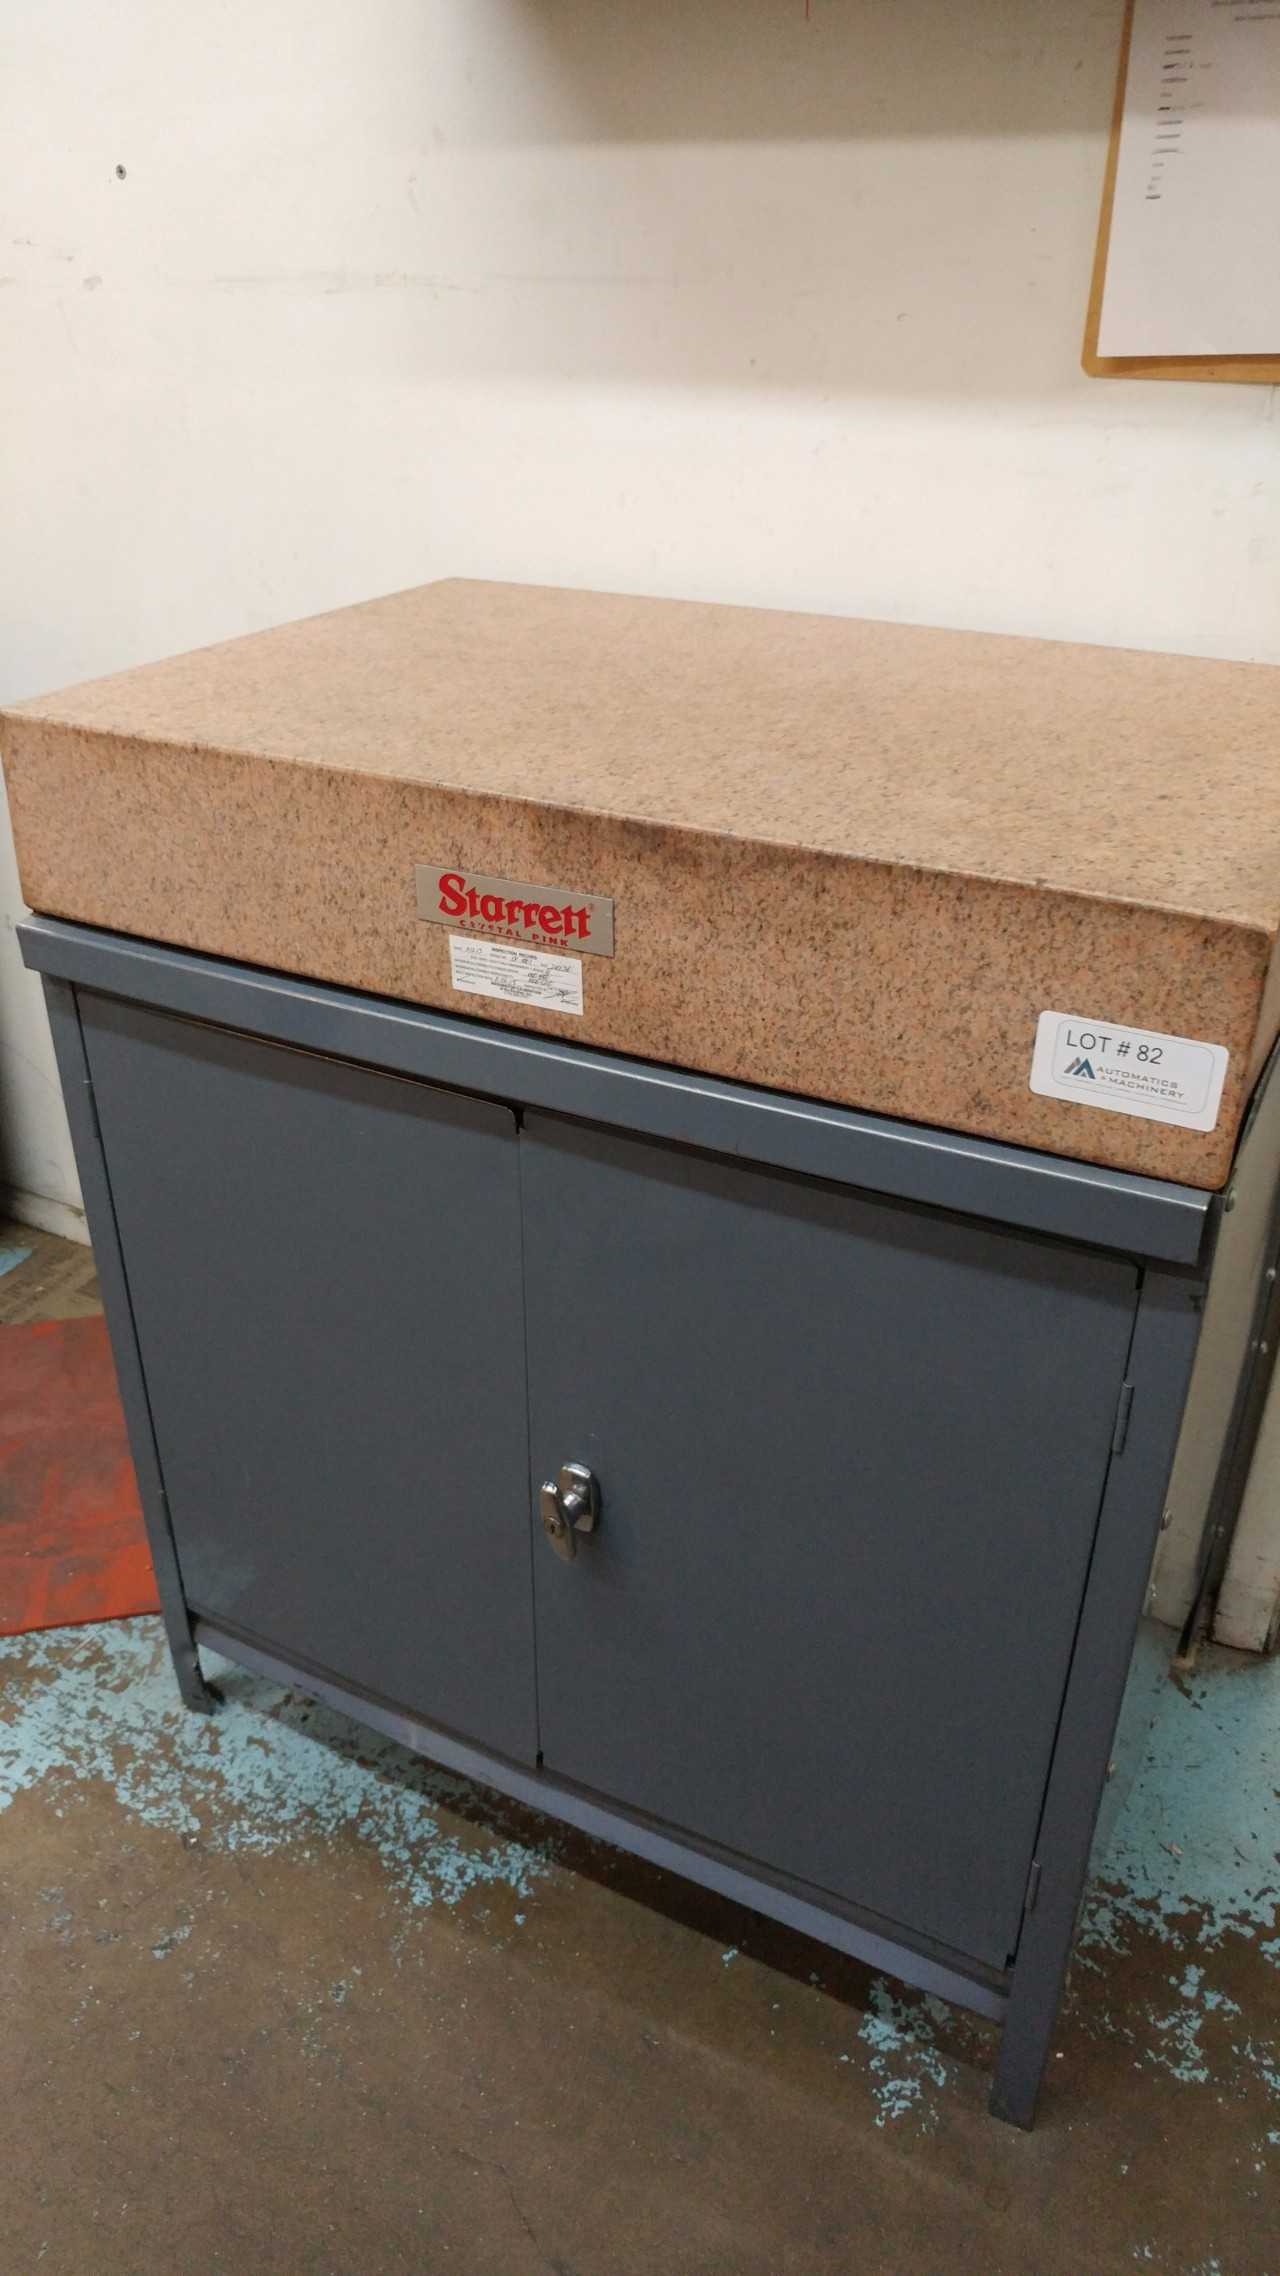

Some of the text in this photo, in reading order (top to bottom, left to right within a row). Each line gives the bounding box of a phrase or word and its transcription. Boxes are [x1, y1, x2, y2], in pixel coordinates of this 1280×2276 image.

[438, 873, 591, 939] Starrett
[459, 919, 570, 947] CRYSTAL PINK
[1066, 1030, 1164, 1065] LOT # 82
[1096, 1064, 1179, 1090] AUTOMATICS
[1108, 1077, 1186, 1100] MACHINERY
